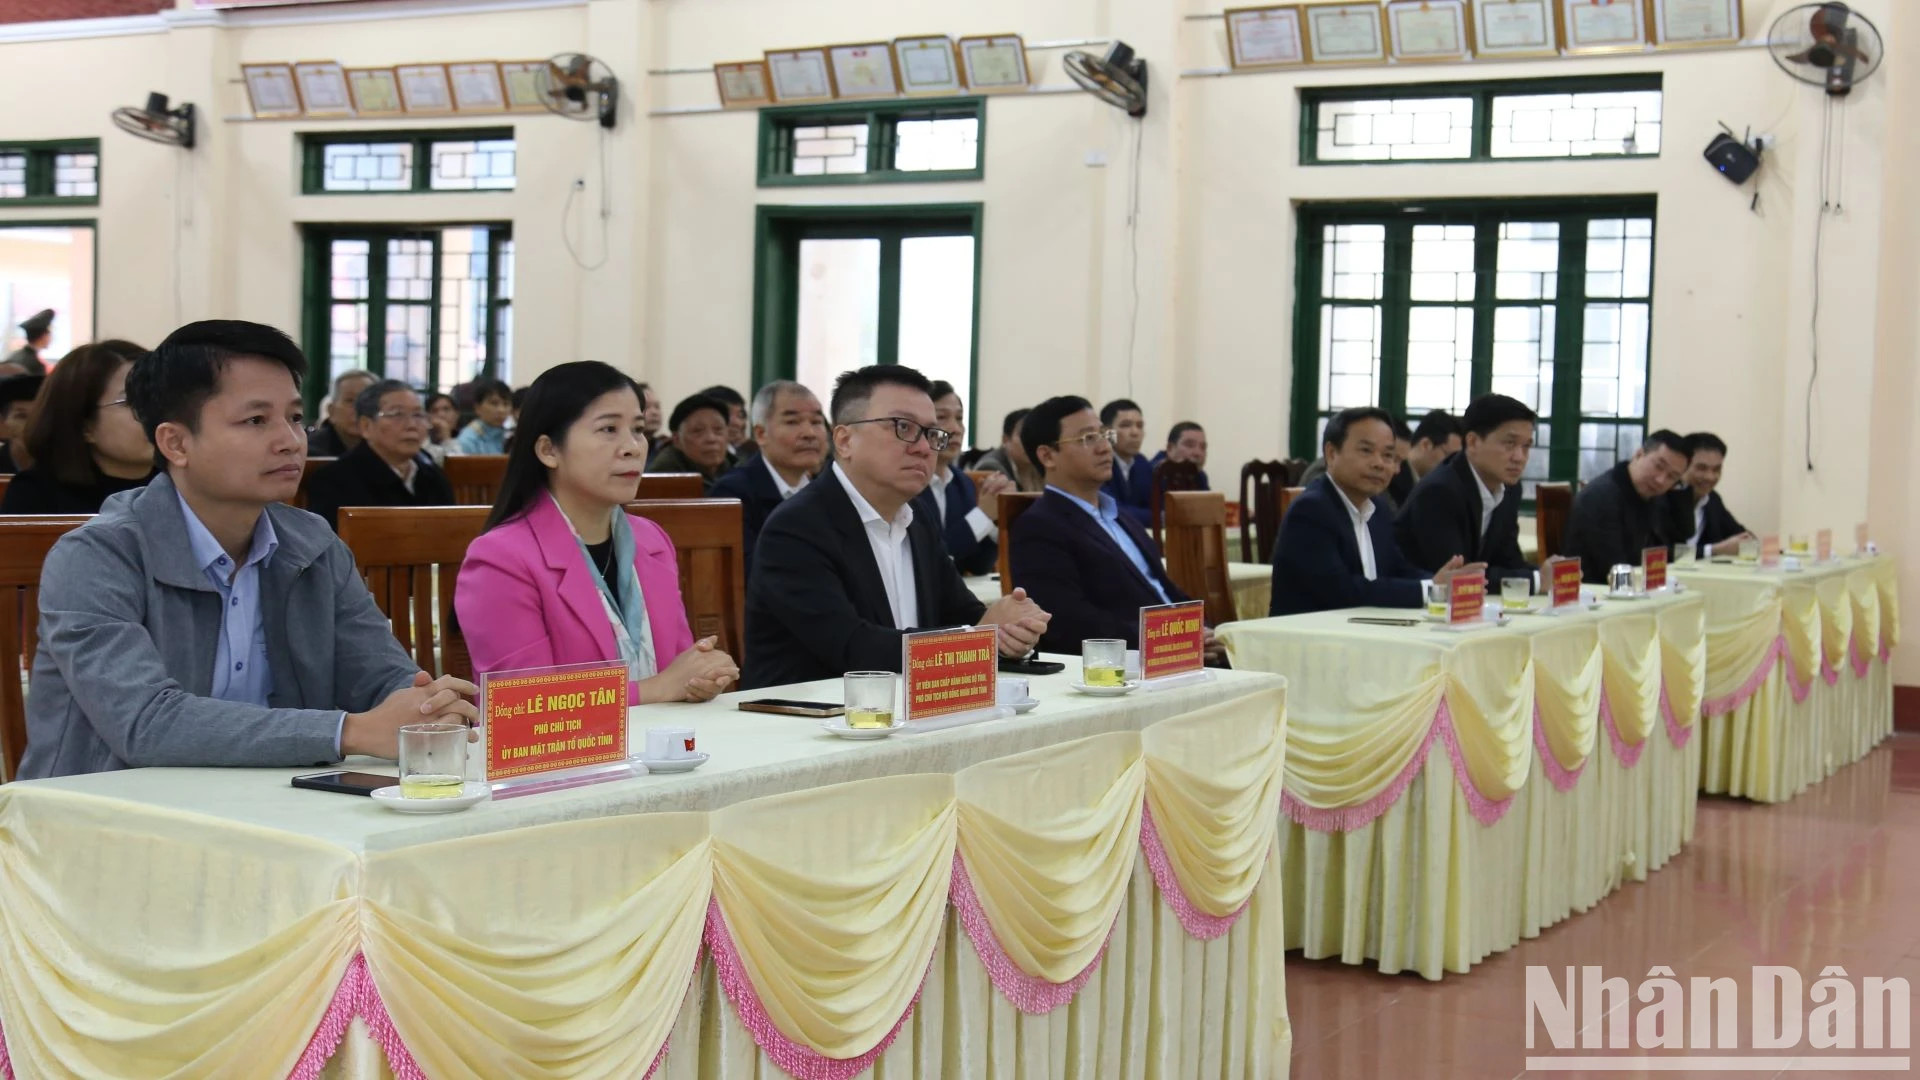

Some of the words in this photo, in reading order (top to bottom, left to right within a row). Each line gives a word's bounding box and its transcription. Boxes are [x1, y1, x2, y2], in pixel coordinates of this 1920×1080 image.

[1162, 620, 1169, 636] LÊ
[1169, 617, 1185, 637] QUỐC
[935, 650, 943, 666] LÊ
[944, 652, 955, 667] THỊ
[956, 649, 977, 664] THANH
[495, 702, 512, 718] Đồng
[513, 702, 525, 715] chí:
[527, 694, 543, 713] LÊ
[548, 693, 585, 712] NGỌC
[589, 687, 616, 705] TÂN
[534, 721, 549, 735] PHÓ
[550, 717, 565, 734] CHỦ
[566, 719, 582, 733] TỊCH
[501, 745, 512, 760] ỦY
[513, 746, 529, 759] BAN
[530, 744, 546, 758] MẶT
[547, 740, 565, 755] TRẬN
[567, 735, 577, 751] TỔ
[577, 733, 596, 750] QUỐC
[597, 731, 613, 746] TỈNH
